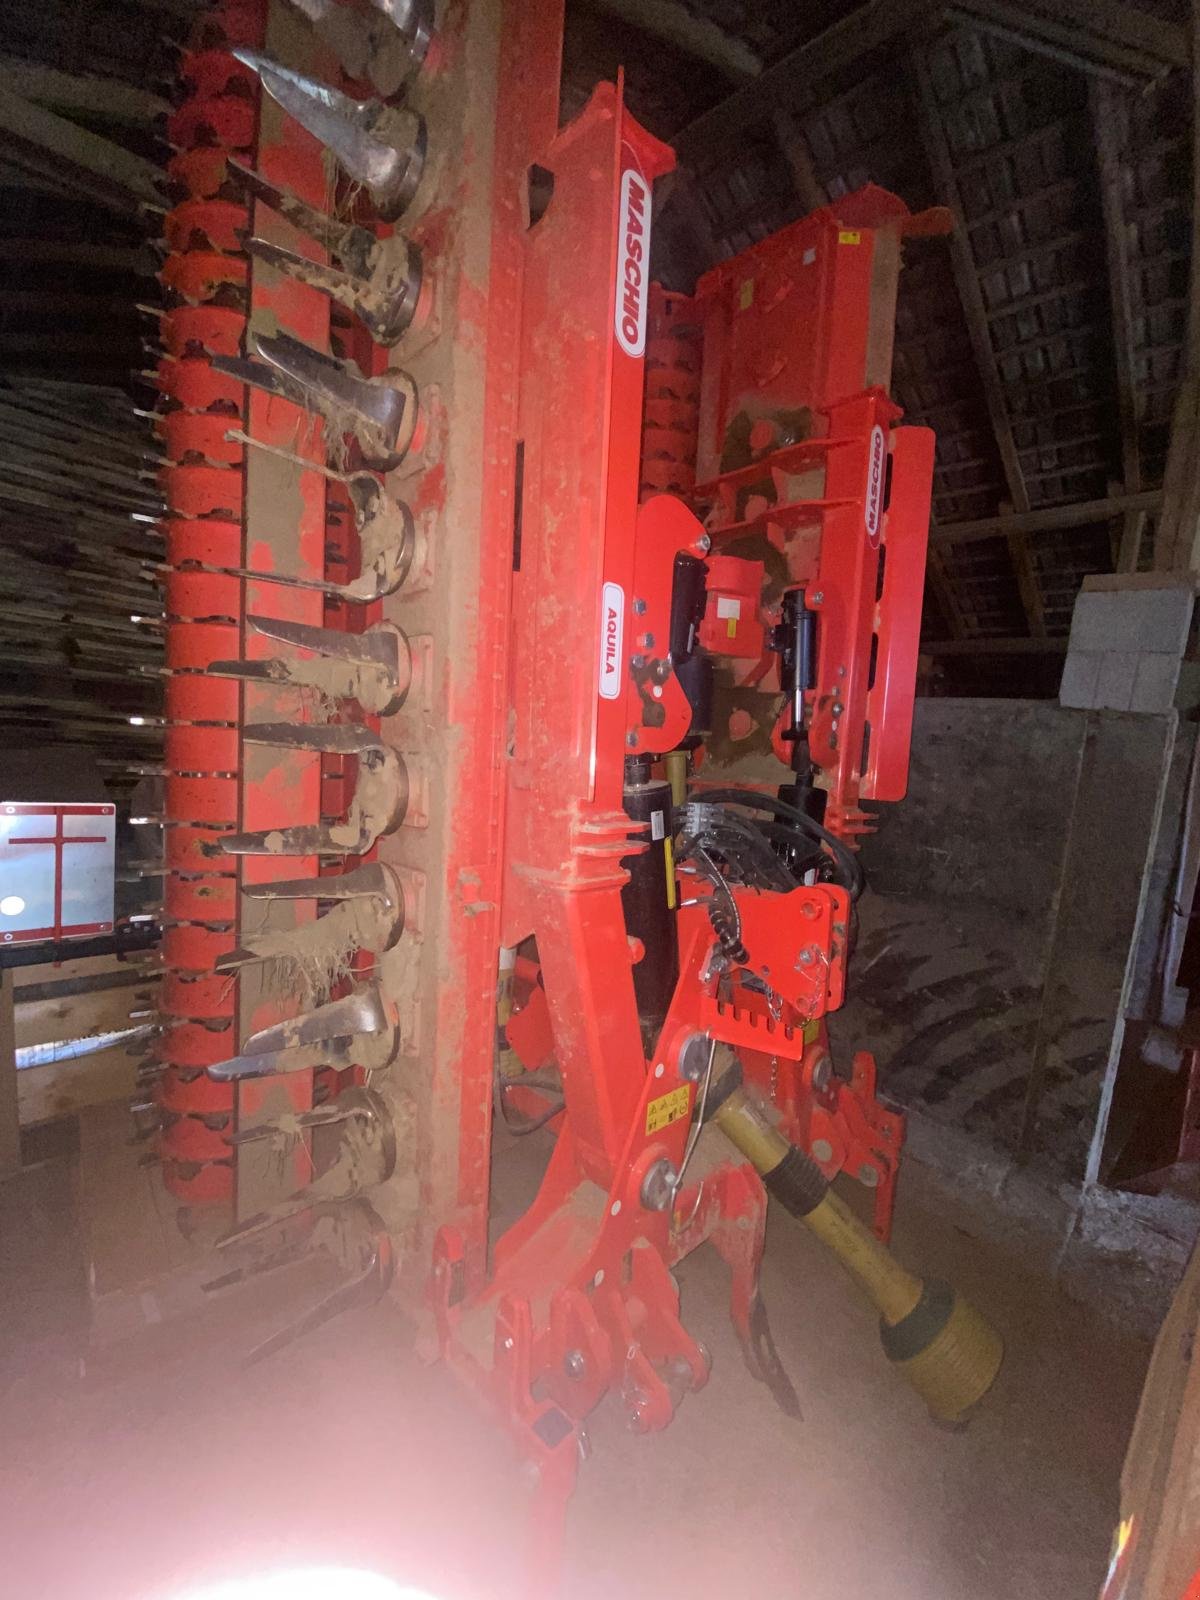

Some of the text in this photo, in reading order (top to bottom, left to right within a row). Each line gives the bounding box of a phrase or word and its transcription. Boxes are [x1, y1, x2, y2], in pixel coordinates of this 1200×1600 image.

[622, 176, 645, 345] MASCHIO
[869, 432, 881, 530] MASCHIO
[606, 607, 617, 674] AQUILA
